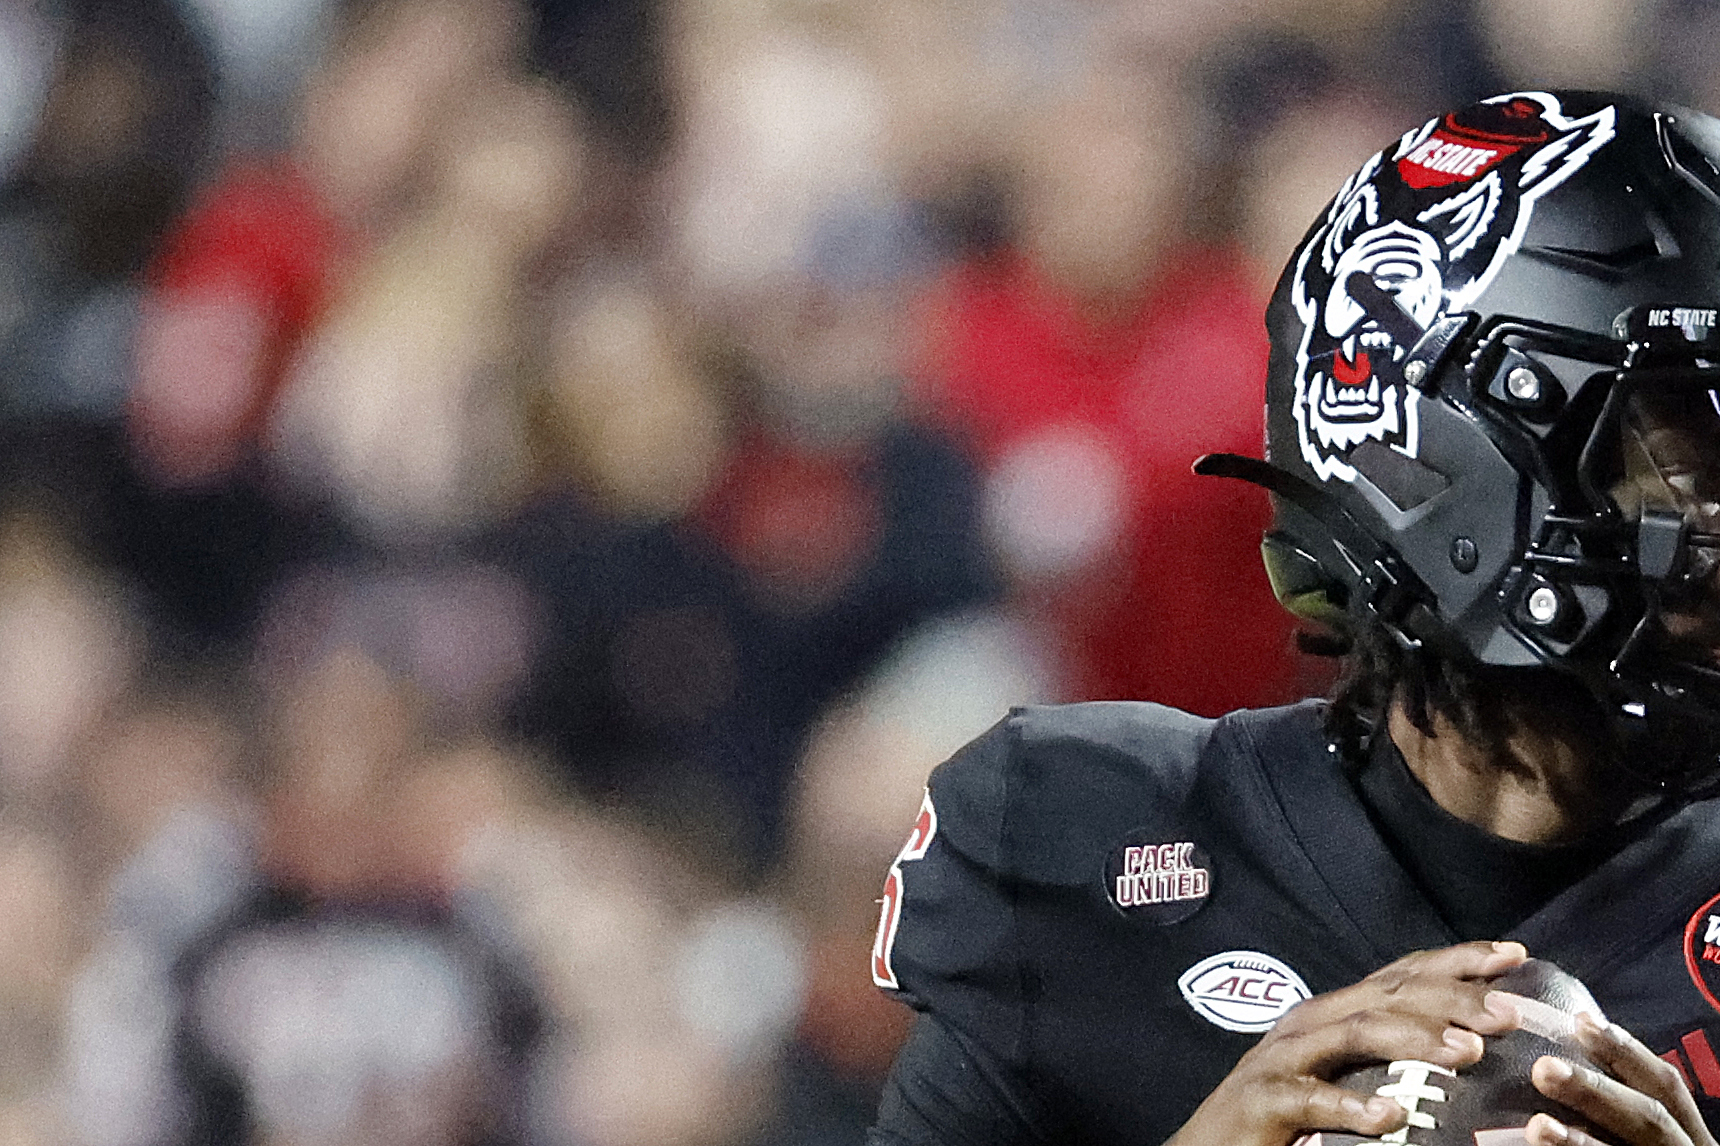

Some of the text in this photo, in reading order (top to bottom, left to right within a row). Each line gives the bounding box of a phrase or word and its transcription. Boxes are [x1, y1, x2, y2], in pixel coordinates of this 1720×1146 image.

[1423, 142, 1497, 176] STATE
[1648, 308, 1718, 327] NC STATE
[1124, 842, 1195, 876] PACK
[1115, 869, 1210, 907] UNITED
[1207, 976, 1289, 1003] ACC
